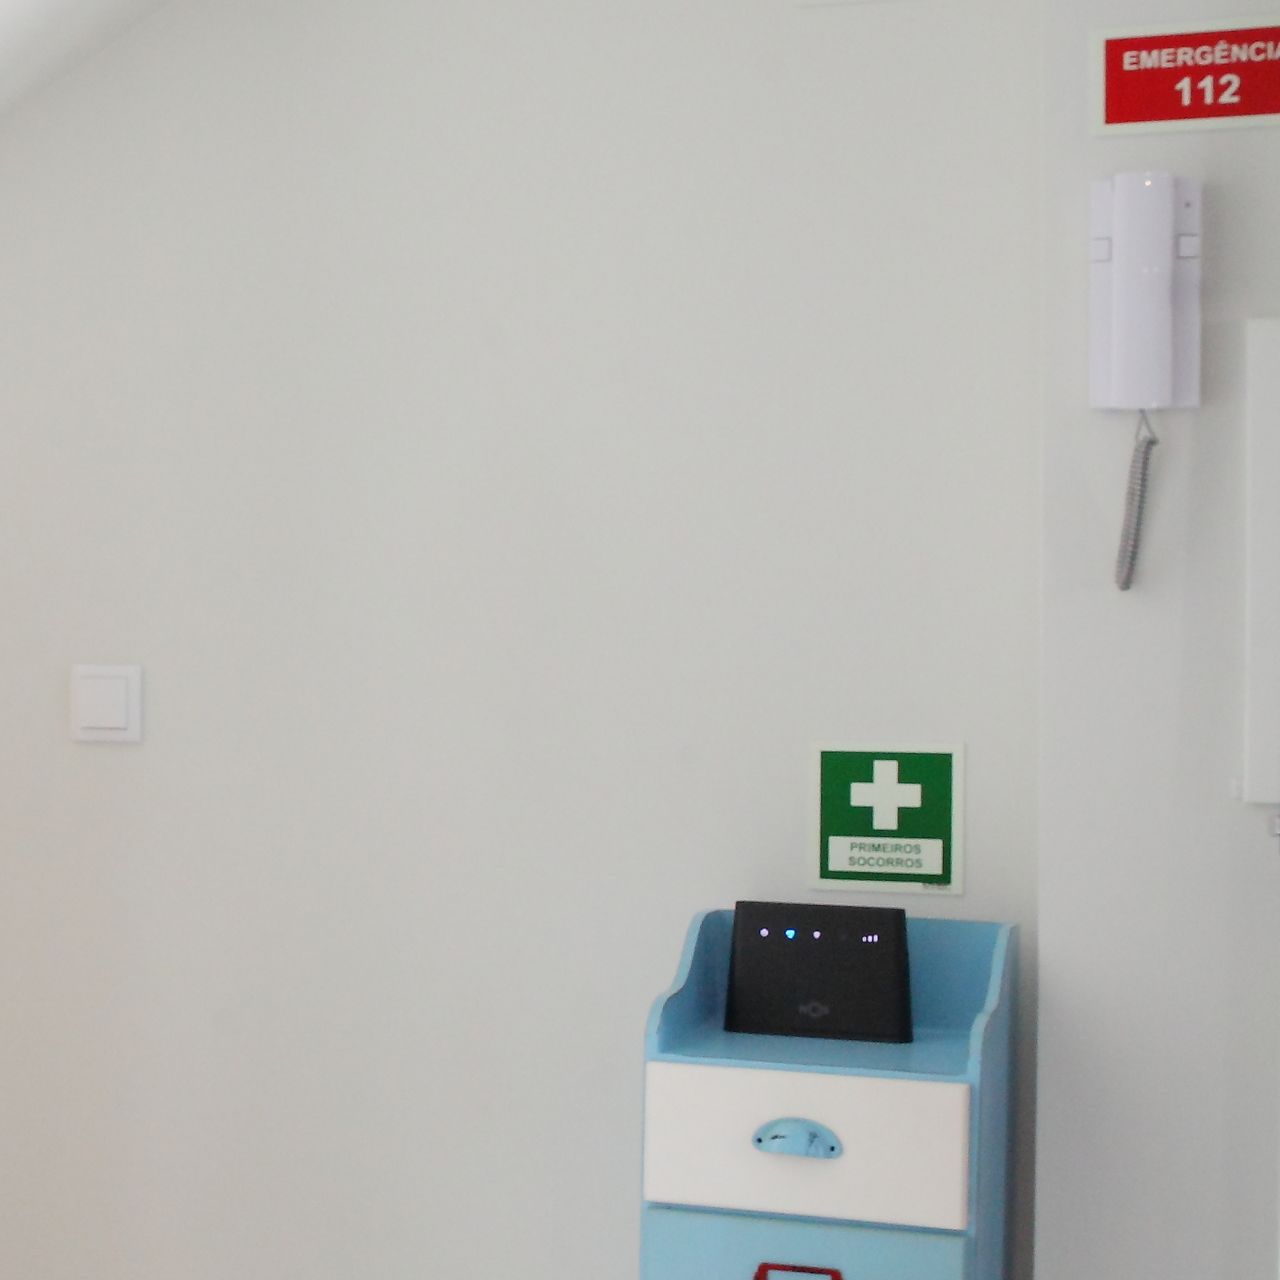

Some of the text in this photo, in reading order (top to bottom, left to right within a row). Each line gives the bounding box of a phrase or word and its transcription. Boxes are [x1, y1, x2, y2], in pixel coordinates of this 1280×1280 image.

[1174, 73, 1241, 107] 112
[849, 841, 922, 855] PRIMEIROS
[848, 855, 923, 869] SOCORROS
